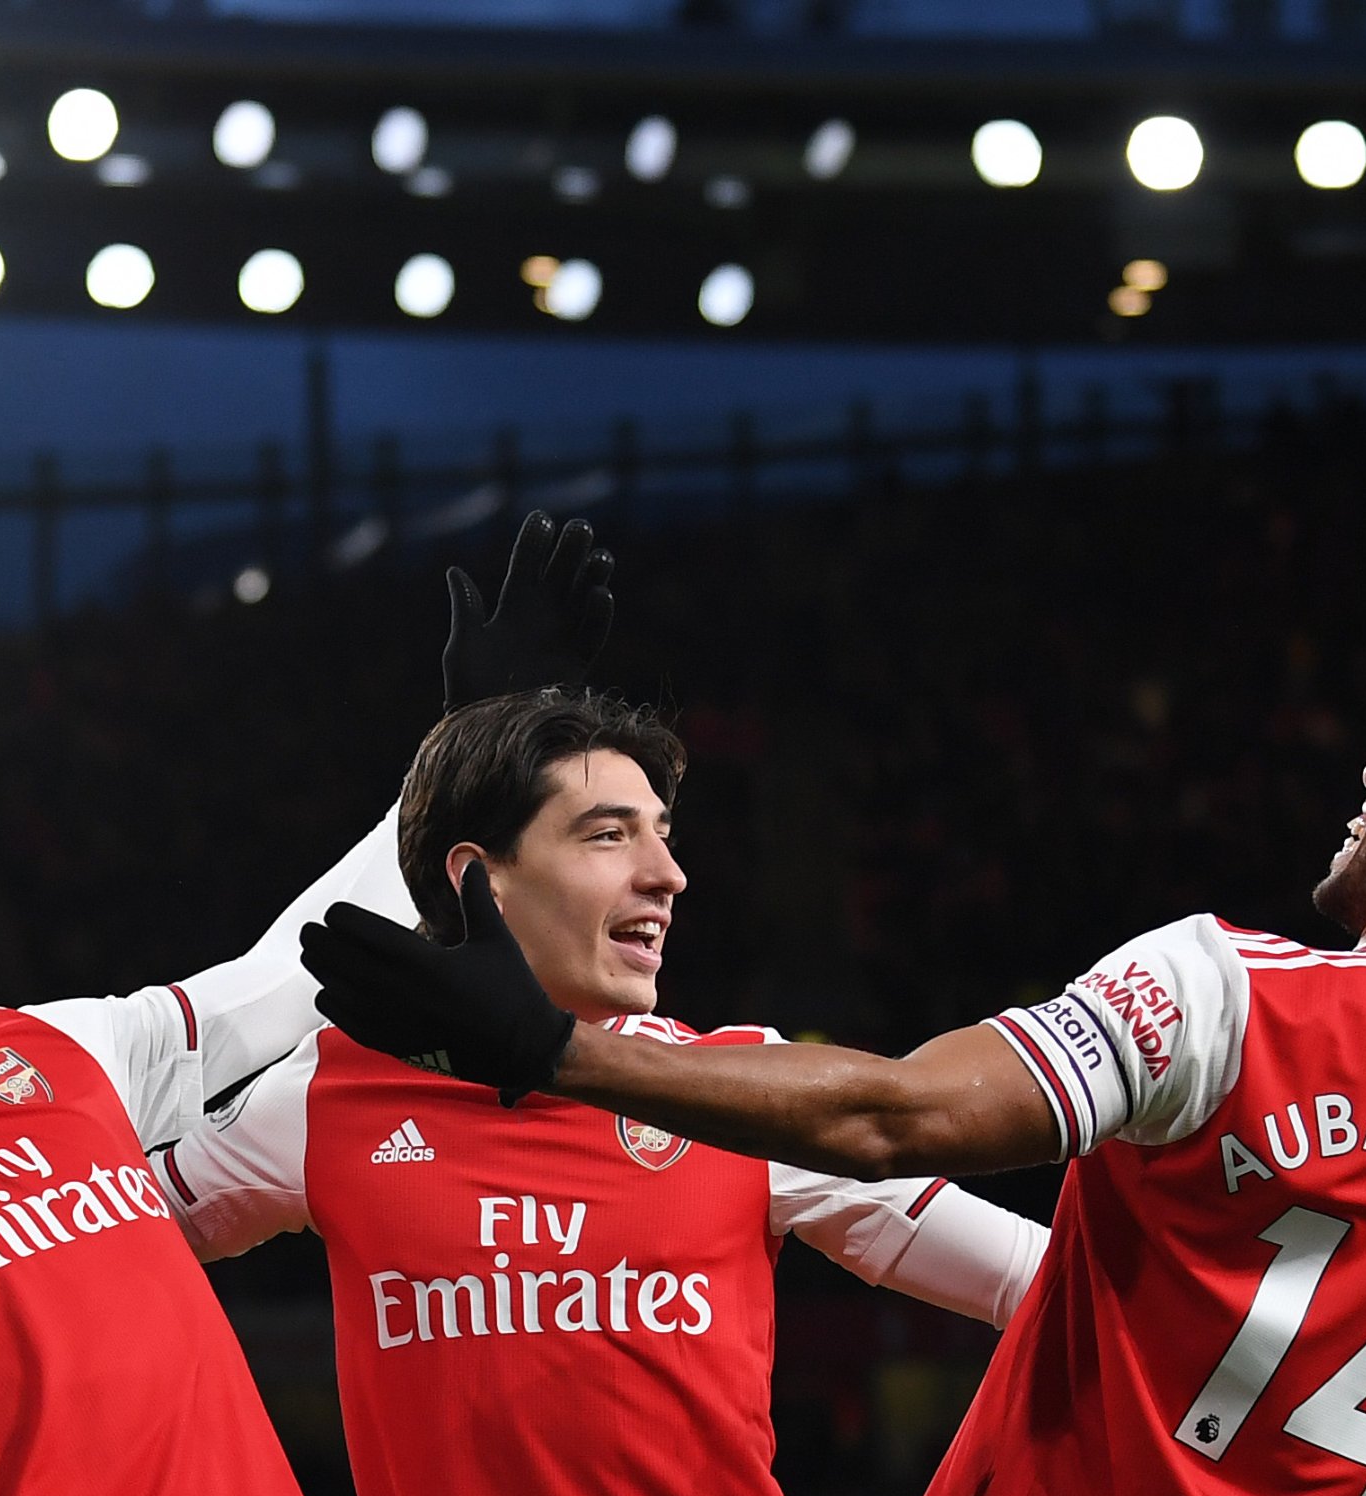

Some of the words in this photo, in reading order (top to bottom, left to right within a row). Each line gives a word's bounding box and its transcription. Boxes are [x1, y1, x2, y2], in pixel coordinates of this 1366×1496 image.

[1123, 961, 1183, 1029] VISIT
[1035, 1001, 1103, 1071] ptain
[371, 1145, 435, 1163] adidas
[479, 1195, 587, 1254] Fly
[369, 1253, 712, 1349] Emirates
